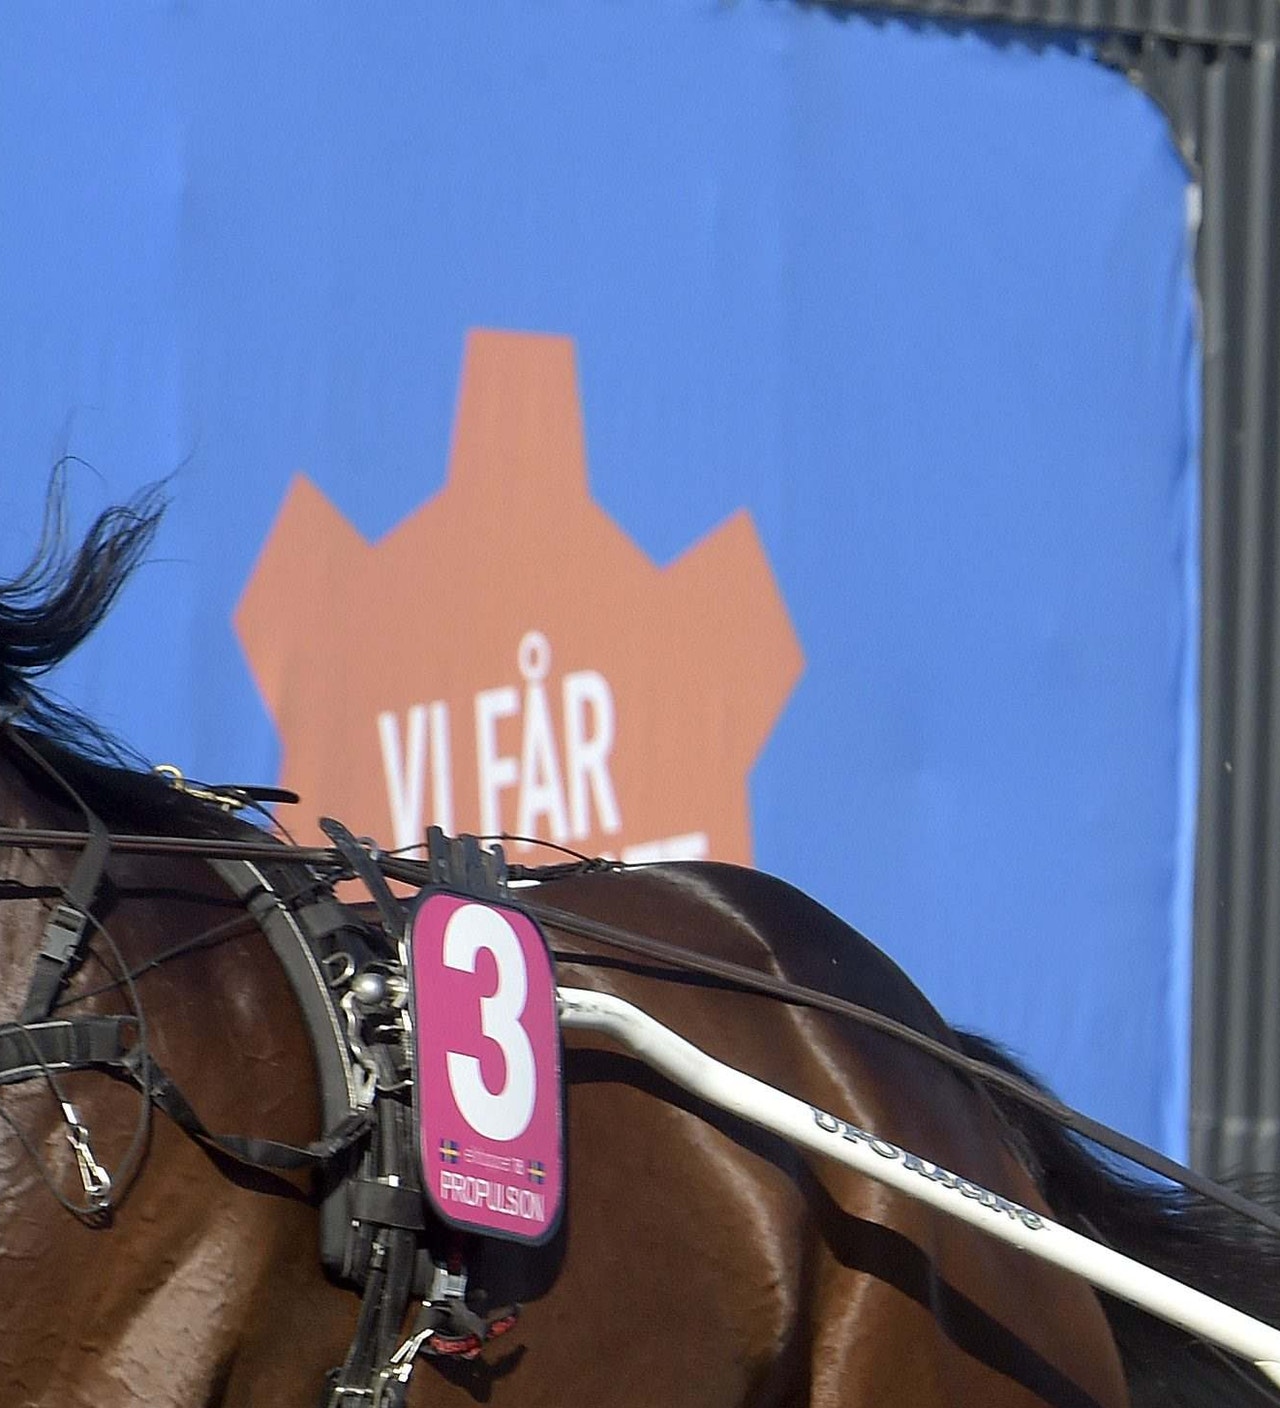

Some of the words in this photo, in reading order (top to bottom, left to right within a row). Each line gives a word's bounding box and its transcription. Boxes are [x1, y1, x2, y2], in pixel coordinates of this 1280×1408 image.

[376, 699, 455, 862] VI
[474, 629, 622, 853] FÅR
[442, 903, 537, 1142] 3
[440, 1169, 545, 1222] PROPULSION
